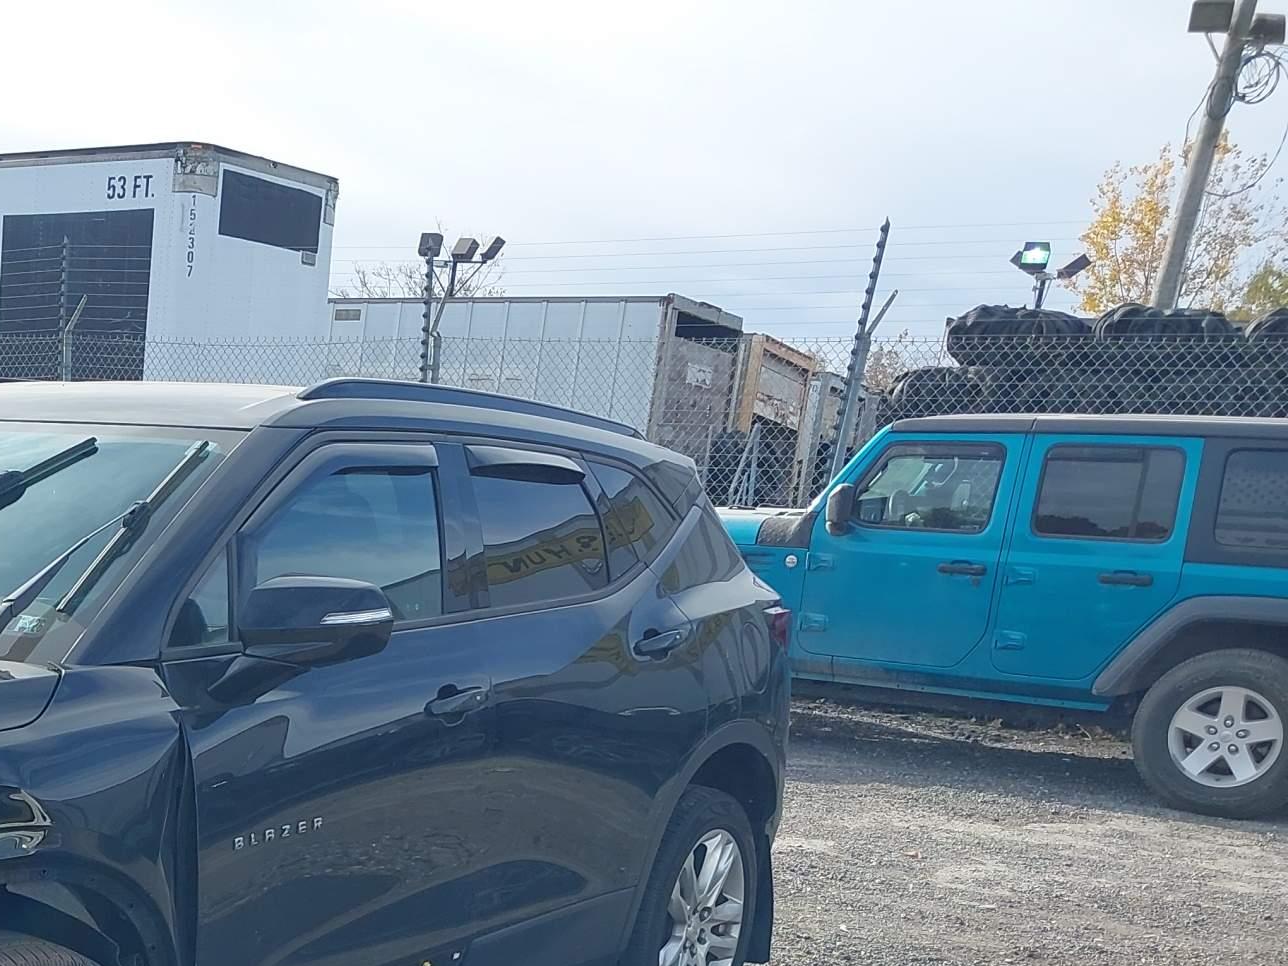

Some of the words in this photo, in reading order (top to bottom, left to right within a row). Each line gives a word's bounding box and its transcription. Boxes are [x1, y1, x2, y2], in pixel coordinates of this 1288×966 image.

[107, 176, 127, 199] 53
[132, 174, 155, 198] FT.
[232, 816, 324, 851] BLAZER
